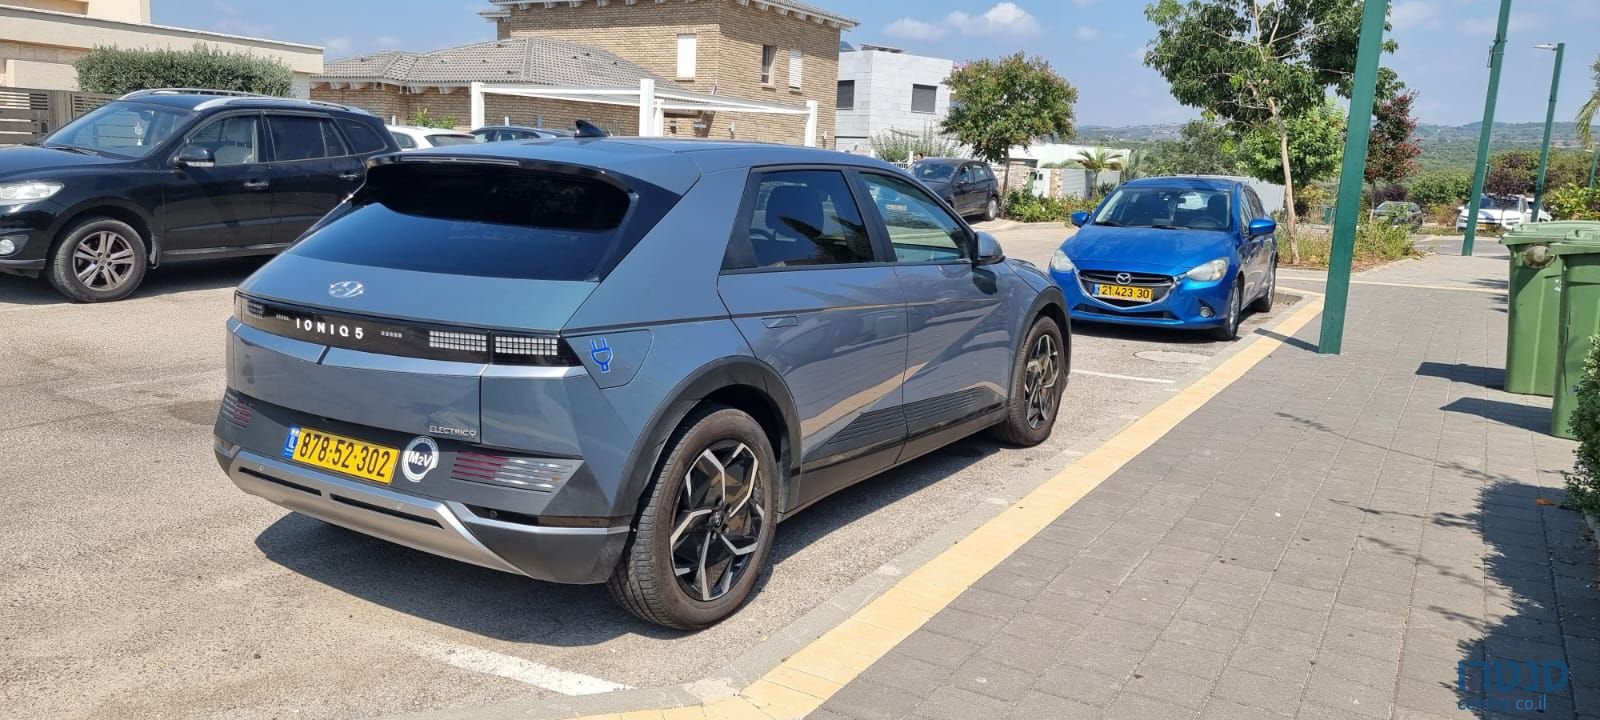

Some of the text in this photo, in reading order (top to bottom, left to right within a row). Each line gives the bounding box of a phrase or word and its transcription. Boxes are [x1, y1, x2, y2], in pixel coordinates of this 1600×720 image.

[296, 318, 364, 339] IONIQ 5
[408, 450, 433, 468] M2V
